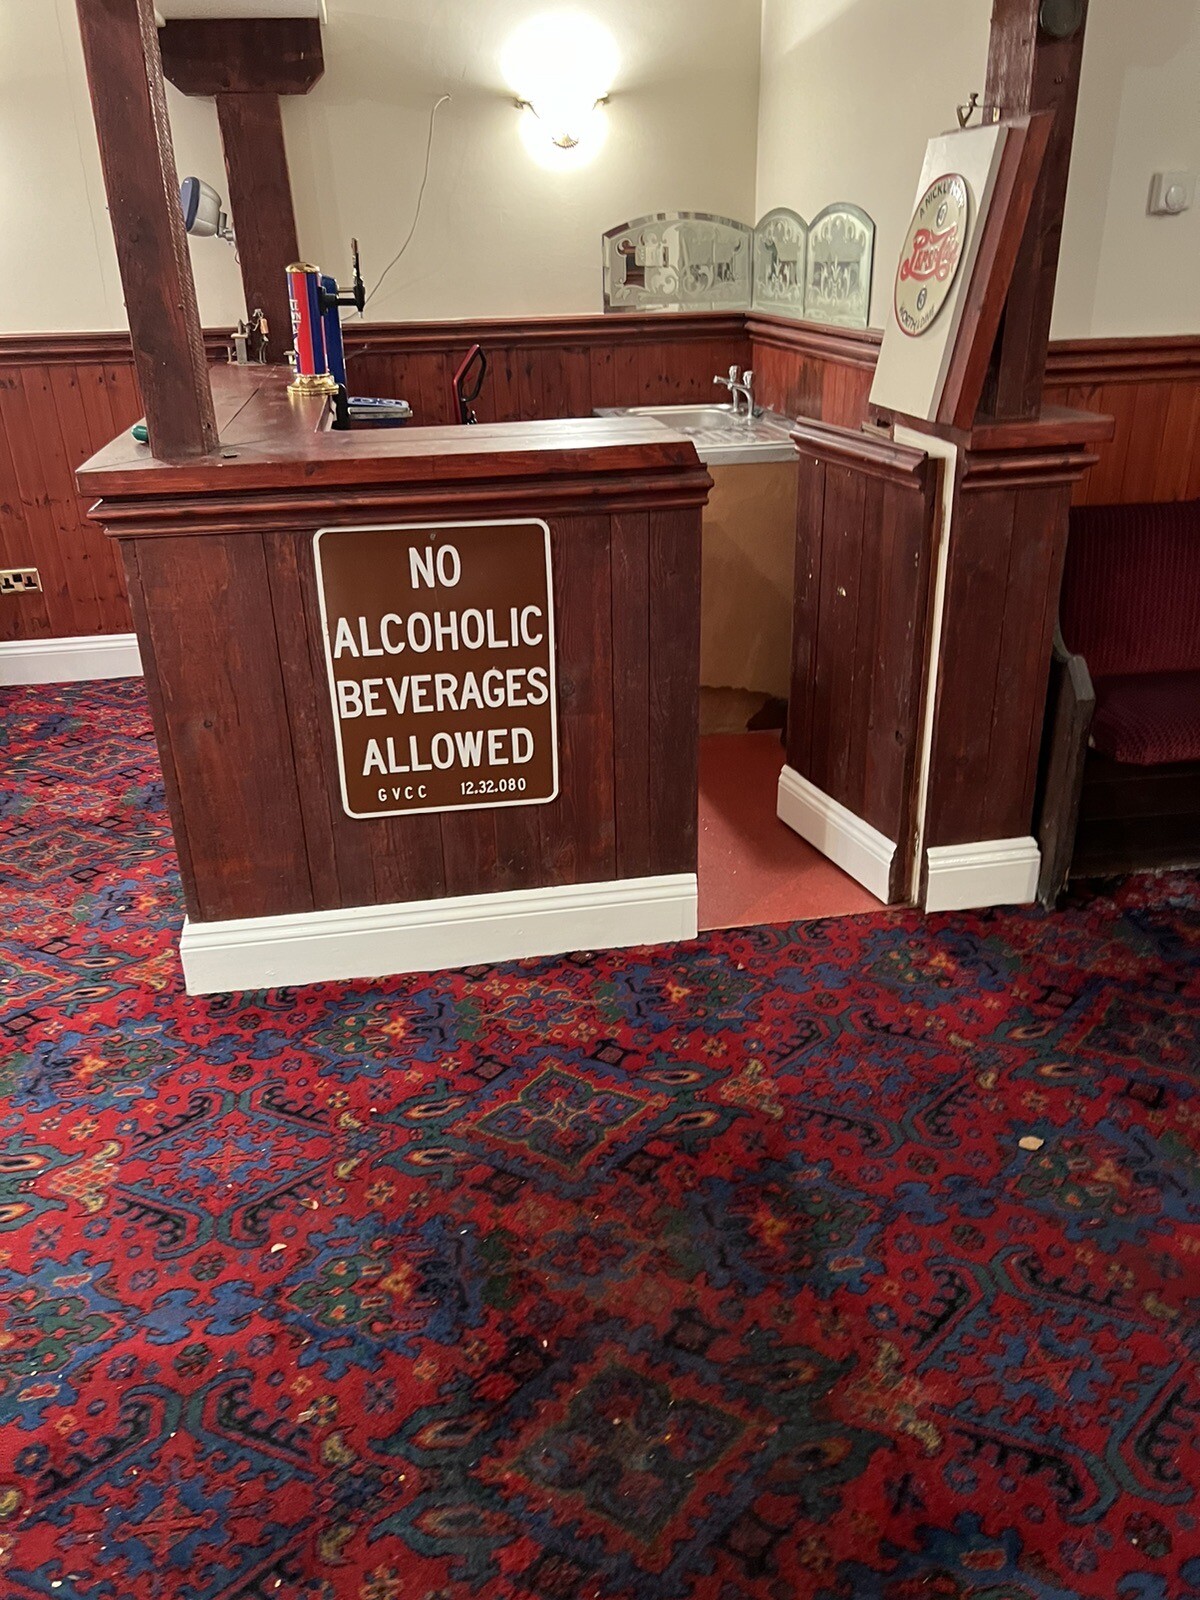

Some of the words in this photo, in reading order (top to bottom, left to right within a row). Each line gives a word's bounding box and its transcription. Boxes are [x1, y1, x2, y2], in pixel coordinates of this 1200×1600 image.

[408, 545, 461, 589] NO
[334, 605, 543, 659] ALCOHOLIC
[337, 667, 549, 719] BEVERAGES
[363, 728, 534, 776] ALLOWED
[461, 777, 526, 795] 12.32.080
